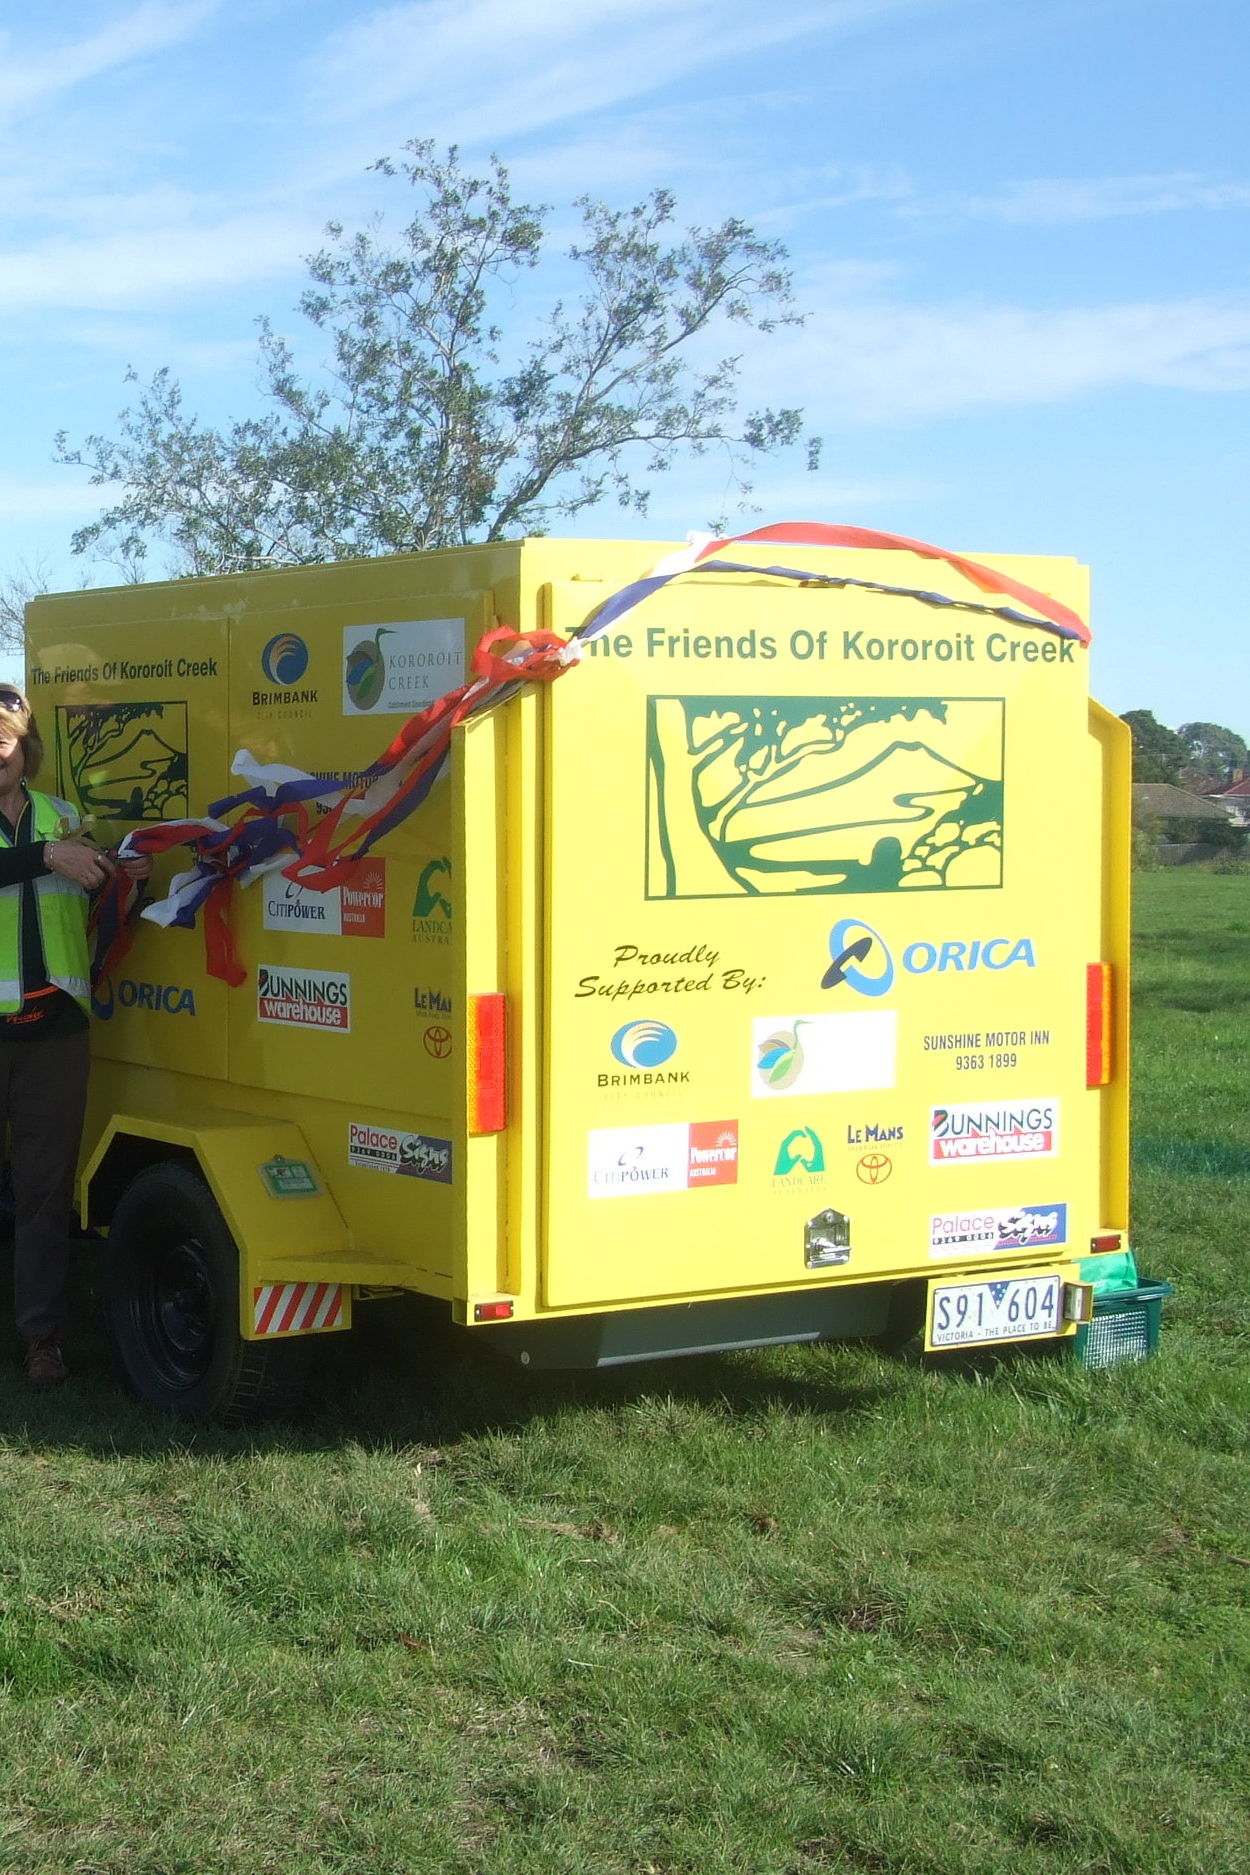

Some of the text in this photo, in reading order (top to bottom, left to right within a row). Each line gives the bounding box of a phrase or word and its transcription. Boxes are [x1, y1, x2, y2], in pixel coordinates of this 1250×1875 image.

[646, 627, 778, 660] Friends
[790, 628, 828, 660] Of
[843, 630, 974, 661] Kororoit
[986, 632, 1075, 663] Creek
[32, 657, 217, 685] The Friends Of Kororoit Creek
[389, 651, 462, 669] KOROROIT
[388, 675, 429, 690] CREEK
[252, 690, 318, 706] BRIMBANK
[268, 900, 326, 919] CITIPOWER
[343, 886, 384, 908] Powercor
[613, 944, 720, 968] Proudly
[902, 938, 1037, 974] ORICA
[258, 968, 348, 1006] BUNNINGS
[574, 968, 767, 1002] Supported By:
[118, 979, 196, 1017] ORICA
[263, 998, 342, 1026] warehouse
[923, 1030, 1050, 1051] SUNSHINE MOTOR INN
[955, 1053, 1017, 1070] 9363 1899
[597, 1071, 691, 1088] BRIMBANK
[932, 1108, 1053, 1138] BUNNINGS
[350, 1123, 398, 1150] Palace
[939, 1132, 1045, 1158] warehouse
[402, 1134, 450, 1170] Signs
[689, 1146, 737, 1165] Powercor
[593, 1167, 670, 1186] CITIPOWER
[932, 1213, 995, 1235] Palace
[1002, 1210, 1059, 1246] Signs
[937, 1283, 1055, 1330] S91 604
[936, 1330, 974, 1344] VICTORIA
[984, 1326, 1000, 1338] THE
[1002, 1324, 1027, 1336] PLACE
[1028, 1321, 1040, 1332] TO
